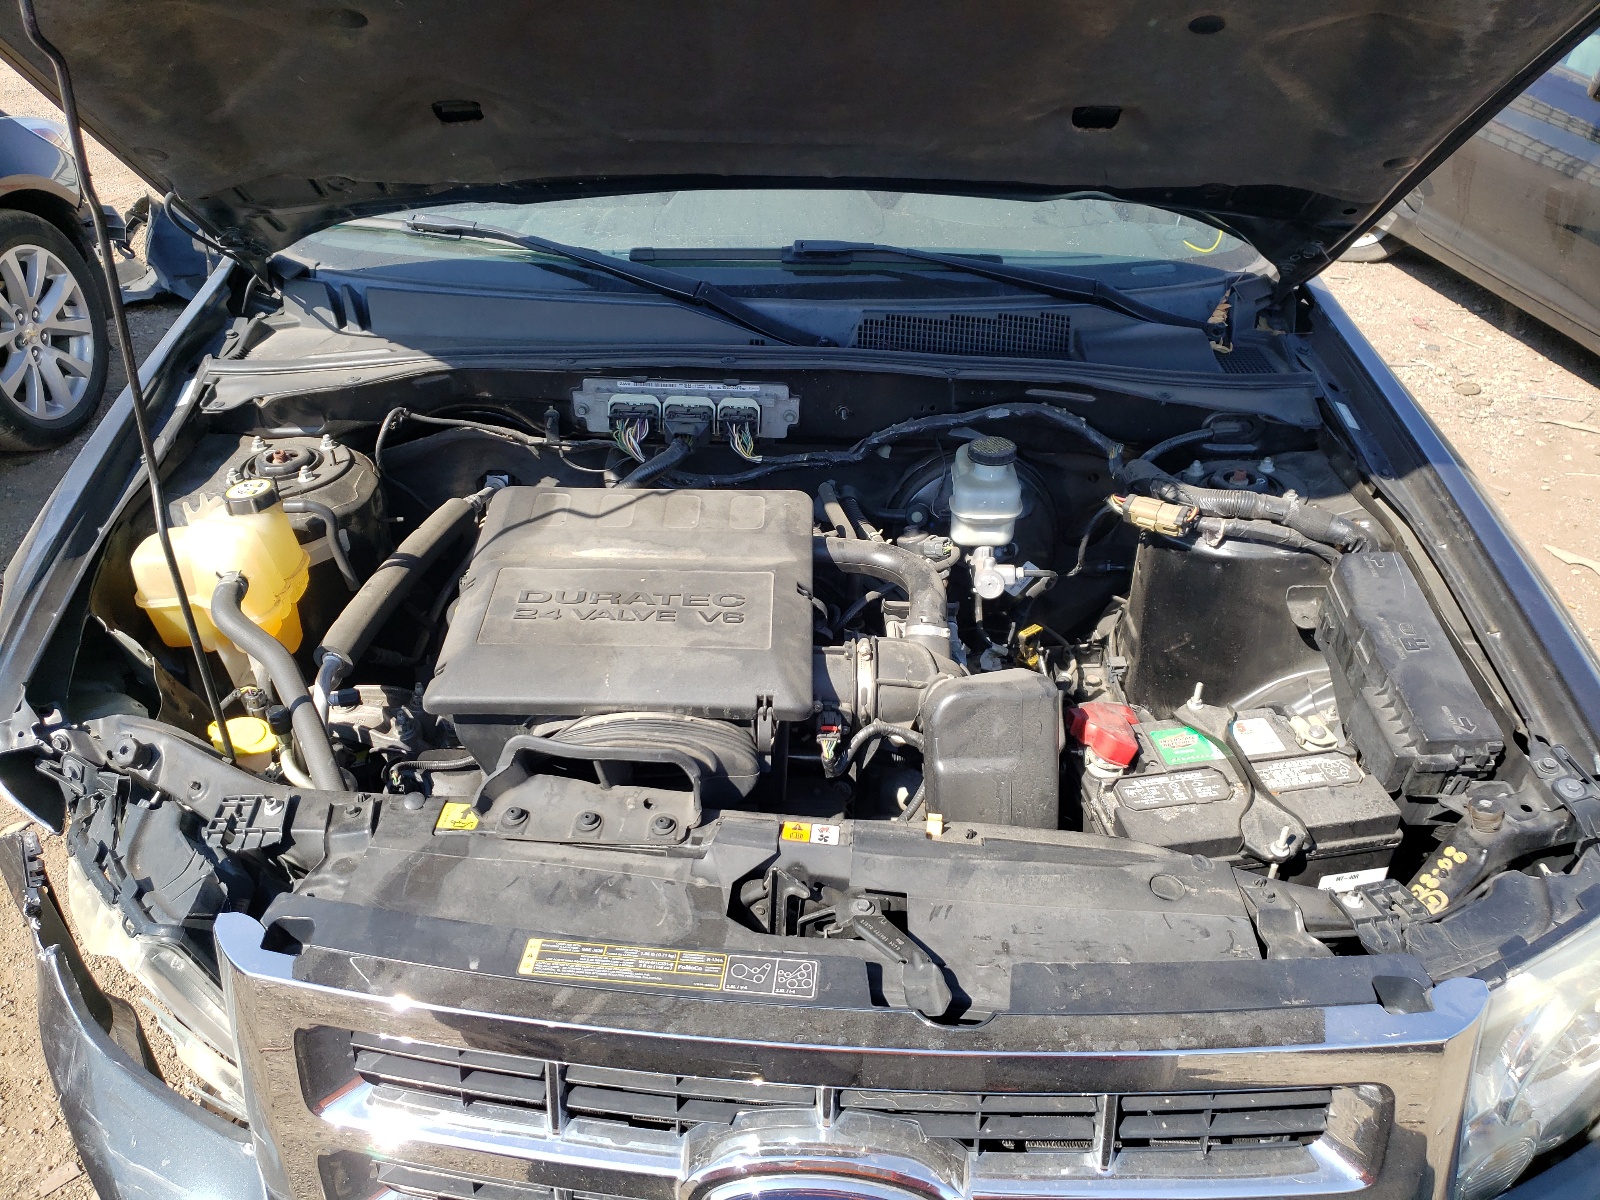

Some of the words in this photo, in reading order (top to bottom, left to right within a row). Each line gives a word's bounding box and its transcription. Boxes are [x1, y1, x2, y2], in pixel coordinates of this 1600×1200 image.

[517, 590, 746, 607] DURATEC
[513, 607, 563, 620] 24
[573, 609, 677, 622] VALVE
[698, 610, 745, 623] V6
